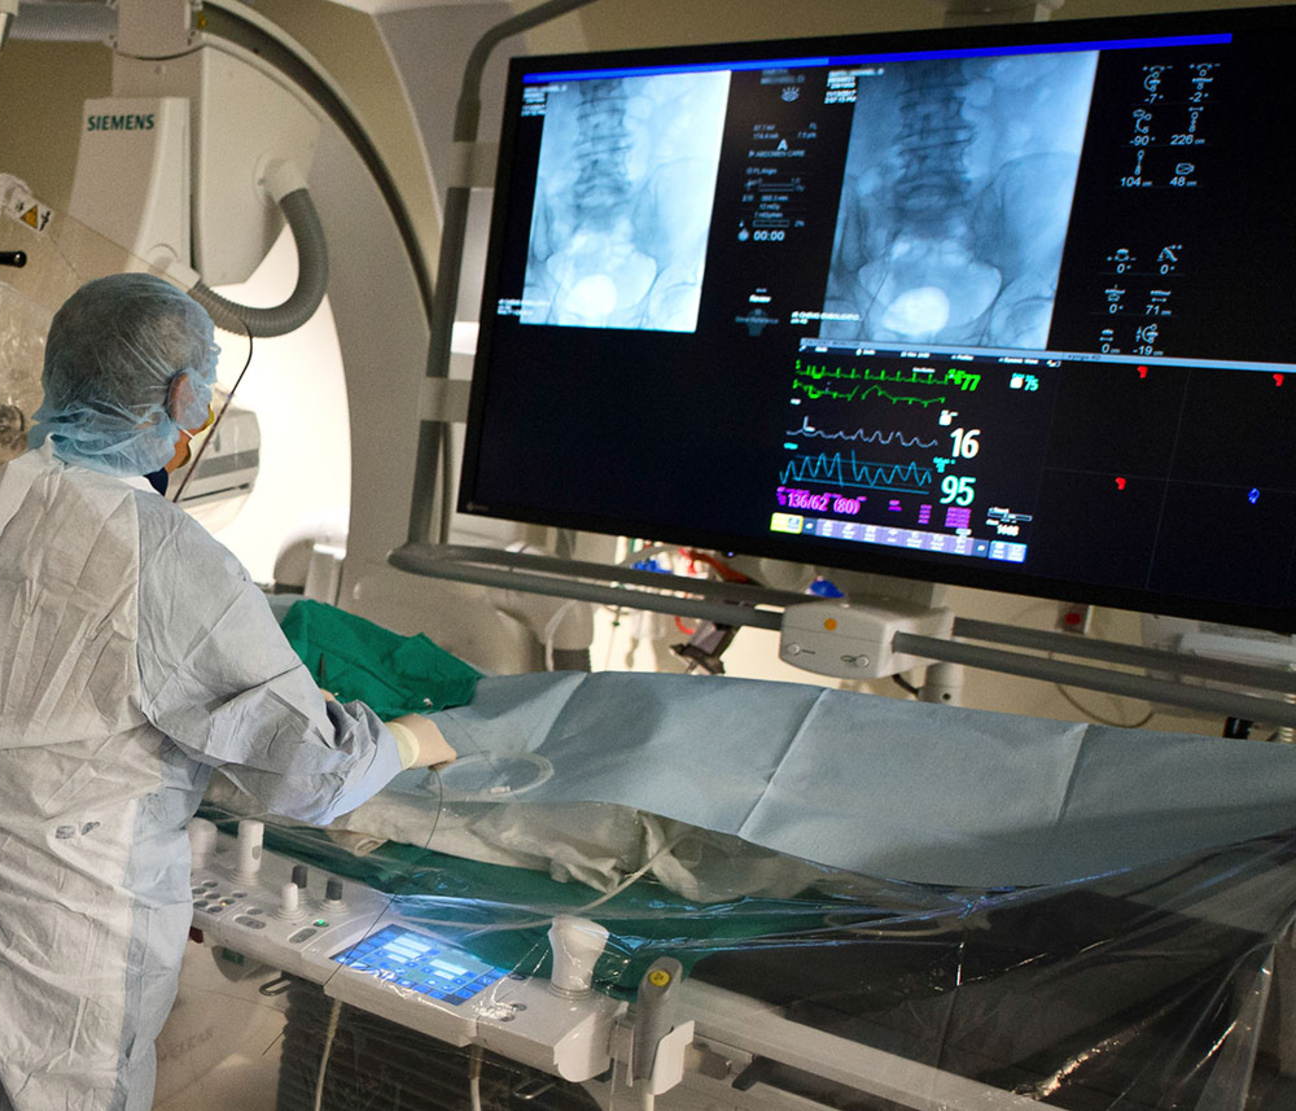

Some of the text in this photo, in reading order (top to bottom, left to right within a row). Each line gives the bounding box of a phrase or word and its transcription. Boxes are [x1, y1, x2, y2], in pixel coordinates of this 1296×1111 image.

[87, 113, 155, 131] SIEMENS
[777, 138, 788, 151] A
[1170, 135, 1194, 145] 226
[1120, 176, 1142, 187] 104
[1170, 176, 1186, 187] 48
[753, 229, 785, 242] 00:00
[1145, 304, 1160, 315] 71
[1101, 343, 1110, 353] 0
[1133, 345, 1153, 356] -19
[961, 373, 981, 391] 77
[1024, 377, 1039, 391] 75
[950, 427, 981, 459] 16
[939, 474, 976, 507] 95
[788, 492, 861, 515] 136/62 (80)
